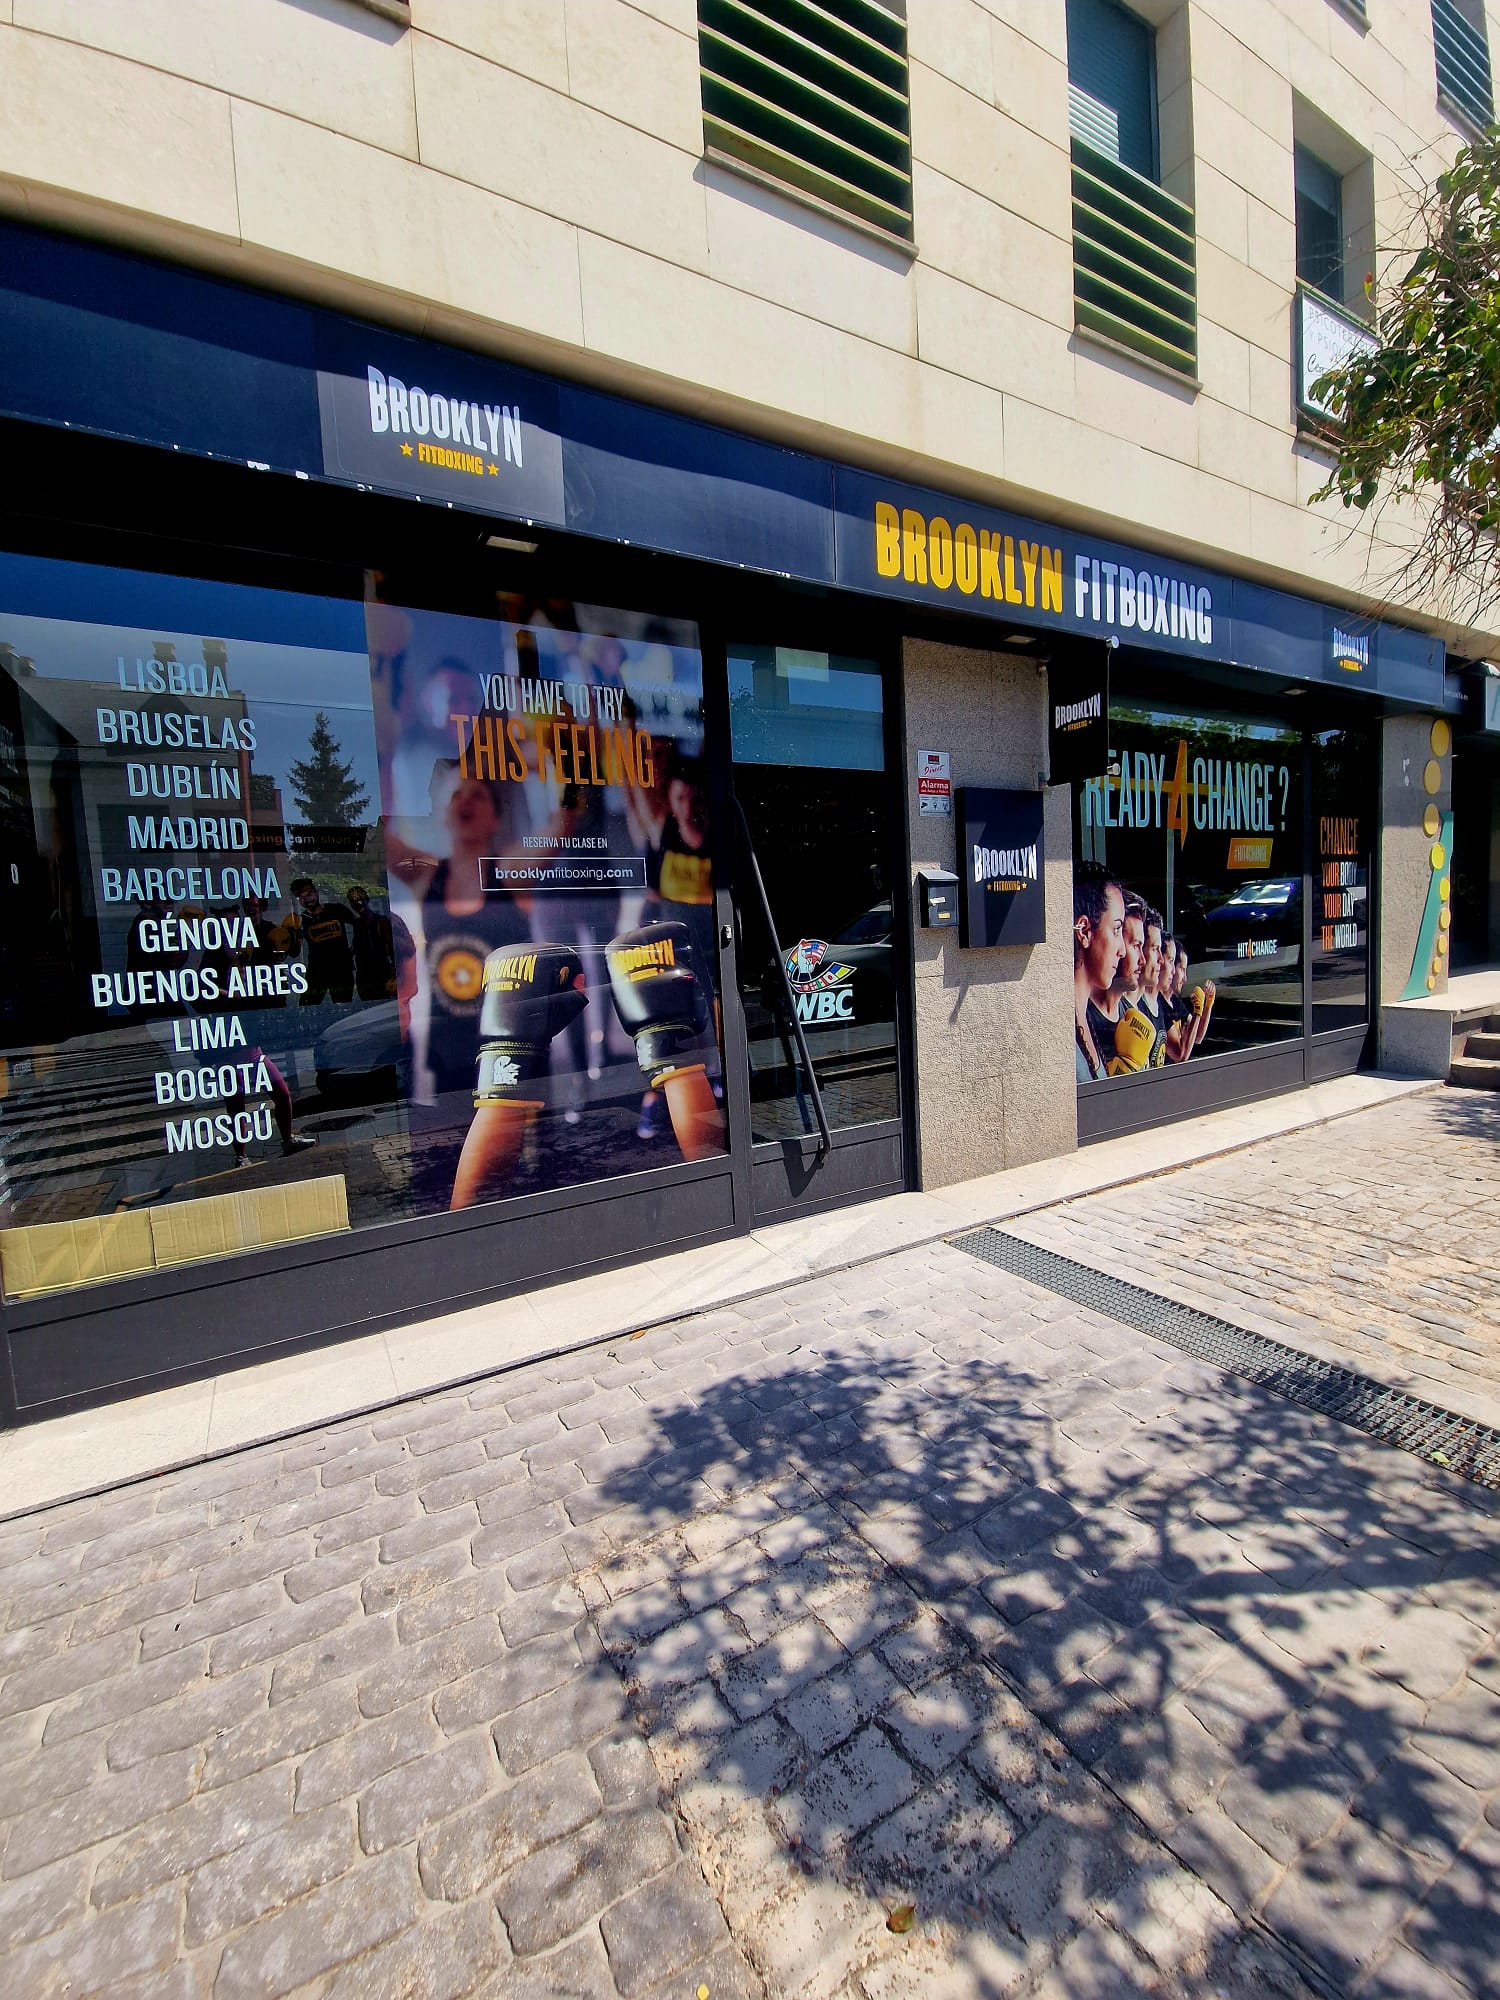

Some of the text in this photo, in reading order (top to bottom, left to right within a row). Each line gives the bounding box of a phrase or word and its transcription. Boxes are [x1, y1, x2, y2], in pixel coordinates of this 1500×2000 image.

[367, 365, 523, 469] BROOKLYN
[418, 442, 483, 476] FITBOXING
[875, 501, 1213, 644] BROOKLYN FITBOXING
[1333, 627, 1369, 665] BROOKLYN
[117, 656, 229, 699] LISBOA
[479, 672, 626, 721] YOU HAVE TO TRY
[96, 708, 257, 751] BRUSELAS
[1055, 692, 1100, 729] BROOKLYN
[450, 714, 655, 789] THIS FEELING
[126, 760, 241, 800] DUBLÍN
[920, 780, 949, 790] Alarma
[128, 815, 249, 850] MADRID
[522, 836, 608, 849] RESERVA TU CLASE EN
[1320, 817, 1359, 855] CHANGE
[495, 867, 633, 881] brooklynfitboxing.com
[973, 843, 1037, 883] BROOKLYN
[1322, 862, 1358, 887] YOUR BODY
[101, 866, 281, 902] BARCELONA
[1324, 892, 1355, 918] YOUR DAY
[138, 912, 260, 953] GÉNOVA
[1322, 923, 1358, 951] THE WORLD
[91, 962, 308, 1008] BUENOS AIRES
[793, 988, 854, 1021] WBC
[172, 1015, 247, 1053] LIMA
[154, 1056, 272, 1105] BOGOTÁ
[165, 1104, 273, 1154] MOSCÚ
